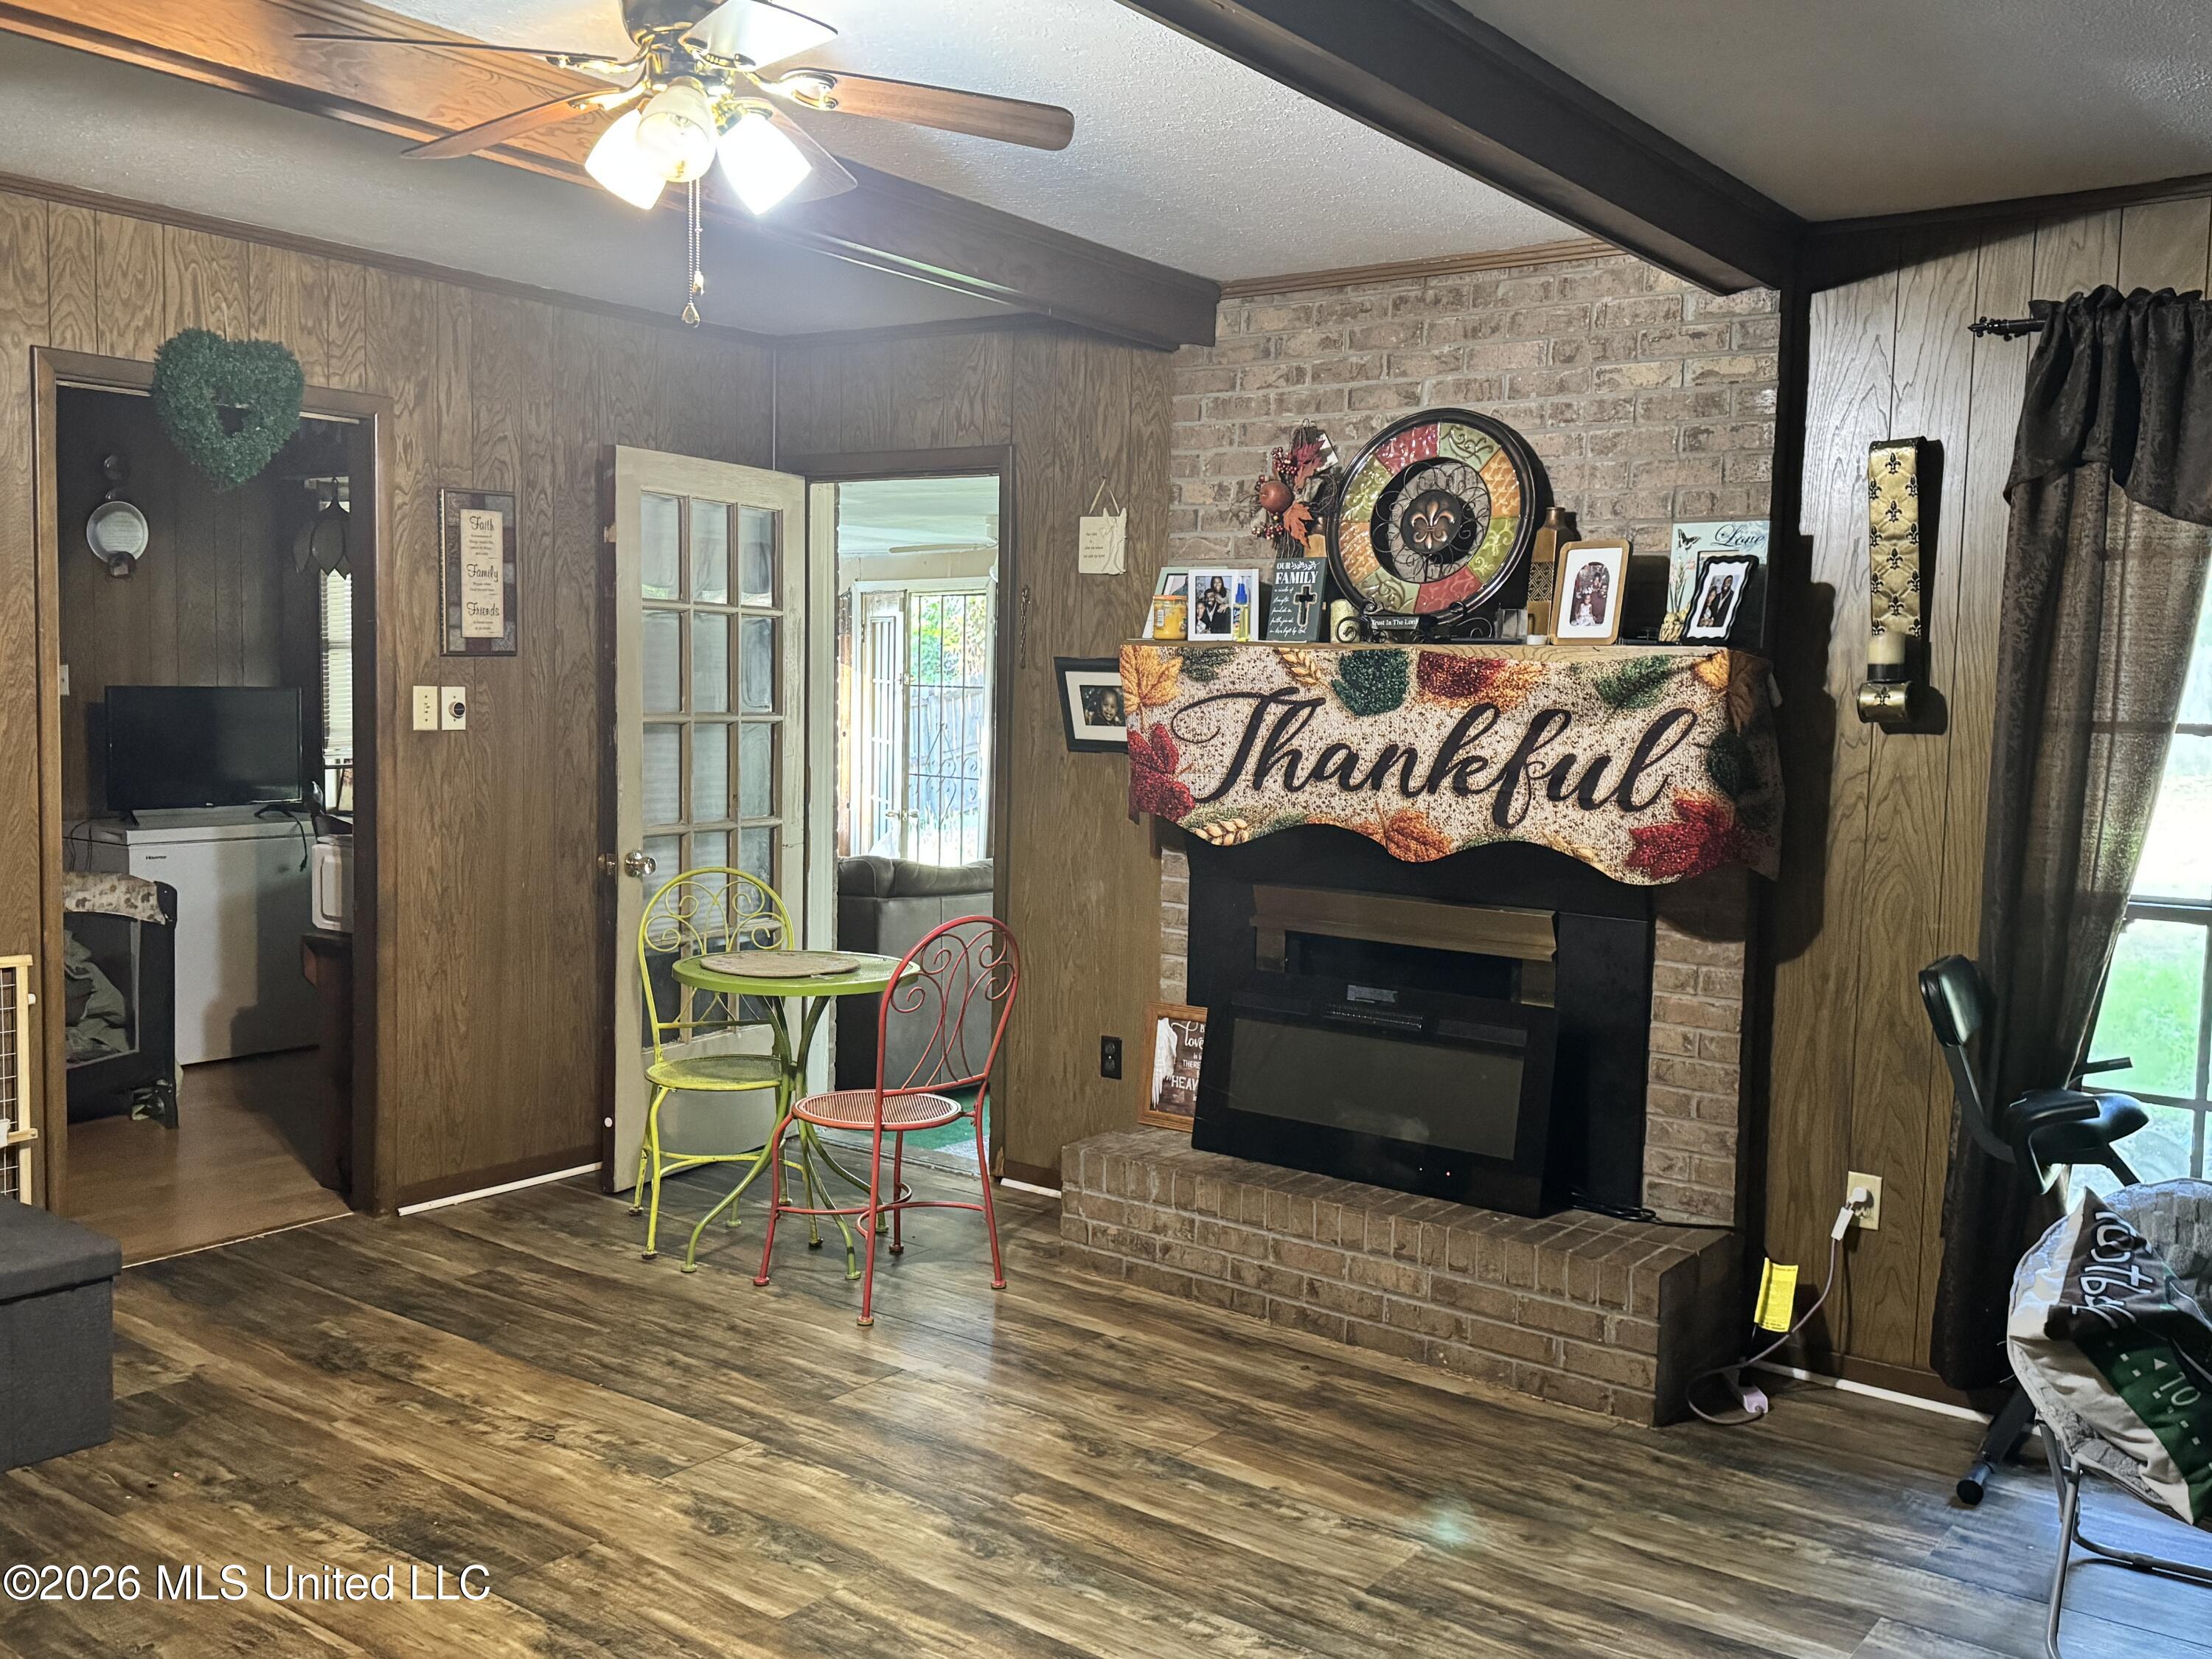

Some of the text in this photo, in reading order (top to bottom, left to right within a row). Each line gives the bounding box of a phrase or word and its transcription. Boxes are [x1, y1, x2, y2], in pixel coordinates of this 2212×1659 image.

[469, 515, 495, 532] Faith
[1711, 524, 1765, 547] Love
[466, 563, 498, 582] Family
[1276, 571, 1318, 584] FAMILY
[466, 601, 500, 617] Friends
[1172, 686, 1697, 829] Thankful
[1183, 1060, 1201, 1068] THERE
[2159, 1370, 2202, 1407] 10
